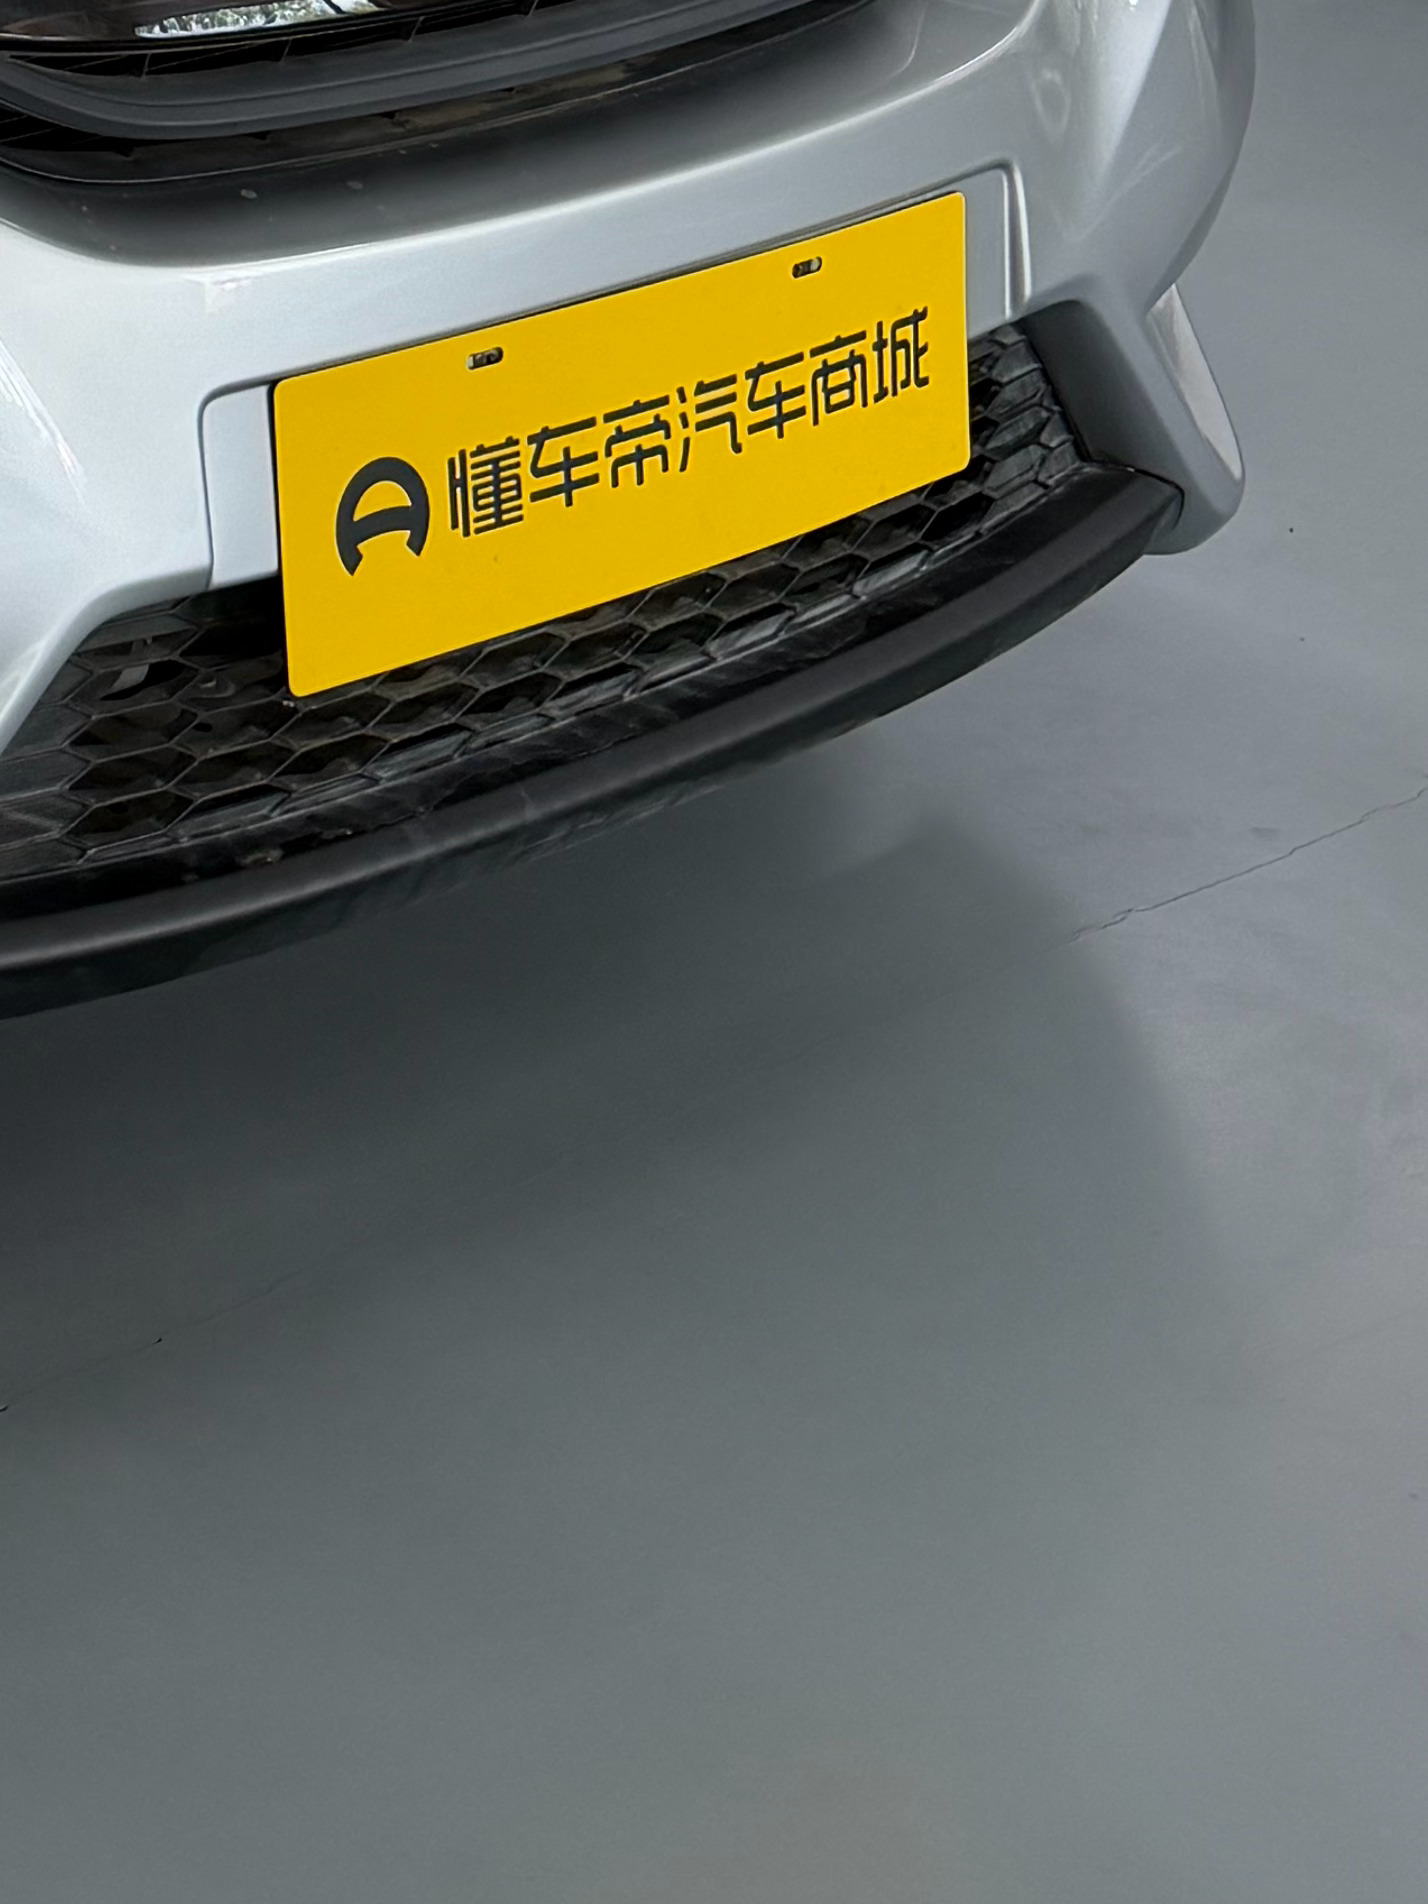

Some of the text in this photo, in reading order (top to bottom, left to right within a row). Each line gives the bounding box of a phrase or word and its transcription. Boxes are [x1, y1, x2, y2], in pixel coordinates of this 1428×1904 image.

[447, 306, 931, 538] 懂车帝汽车商城
